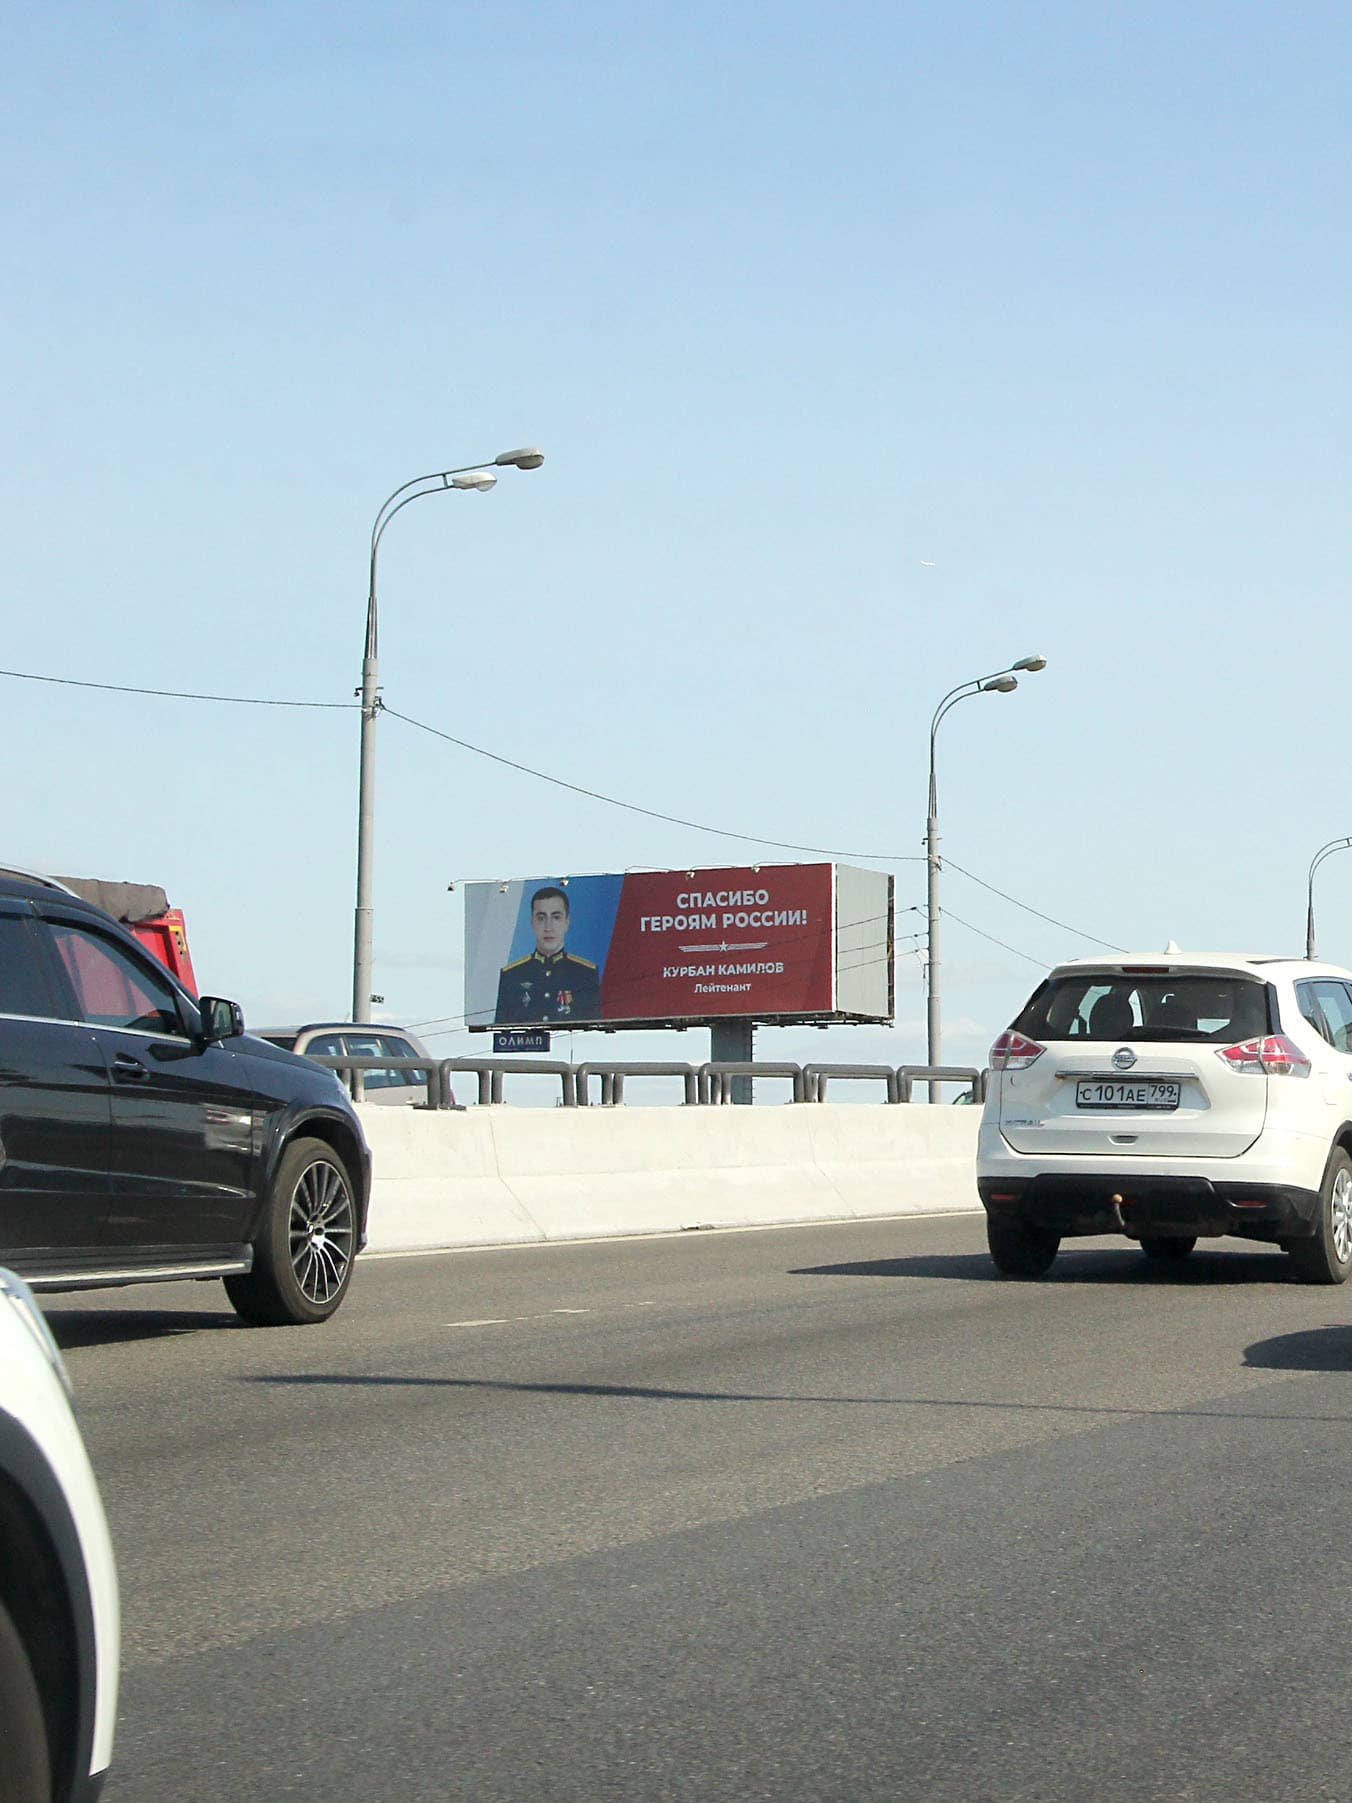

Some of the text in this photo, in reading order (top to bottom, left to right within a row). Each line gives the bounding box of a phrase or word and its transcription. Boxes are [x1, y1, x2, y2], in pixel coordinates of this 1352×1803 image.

[676, 889, 769, 909] СПАСИБО
[640, 909, 808, 932] ГЕРОЯМ РОССИИ!
[663, 962, 784, 978] КУРБАН КАМИЛОВ
[694, 983, 752, 993] Лейтенант
[499, 1036, 542, 1046] ОЛИМП
[1151, 1084, 1174, 1098] 799
